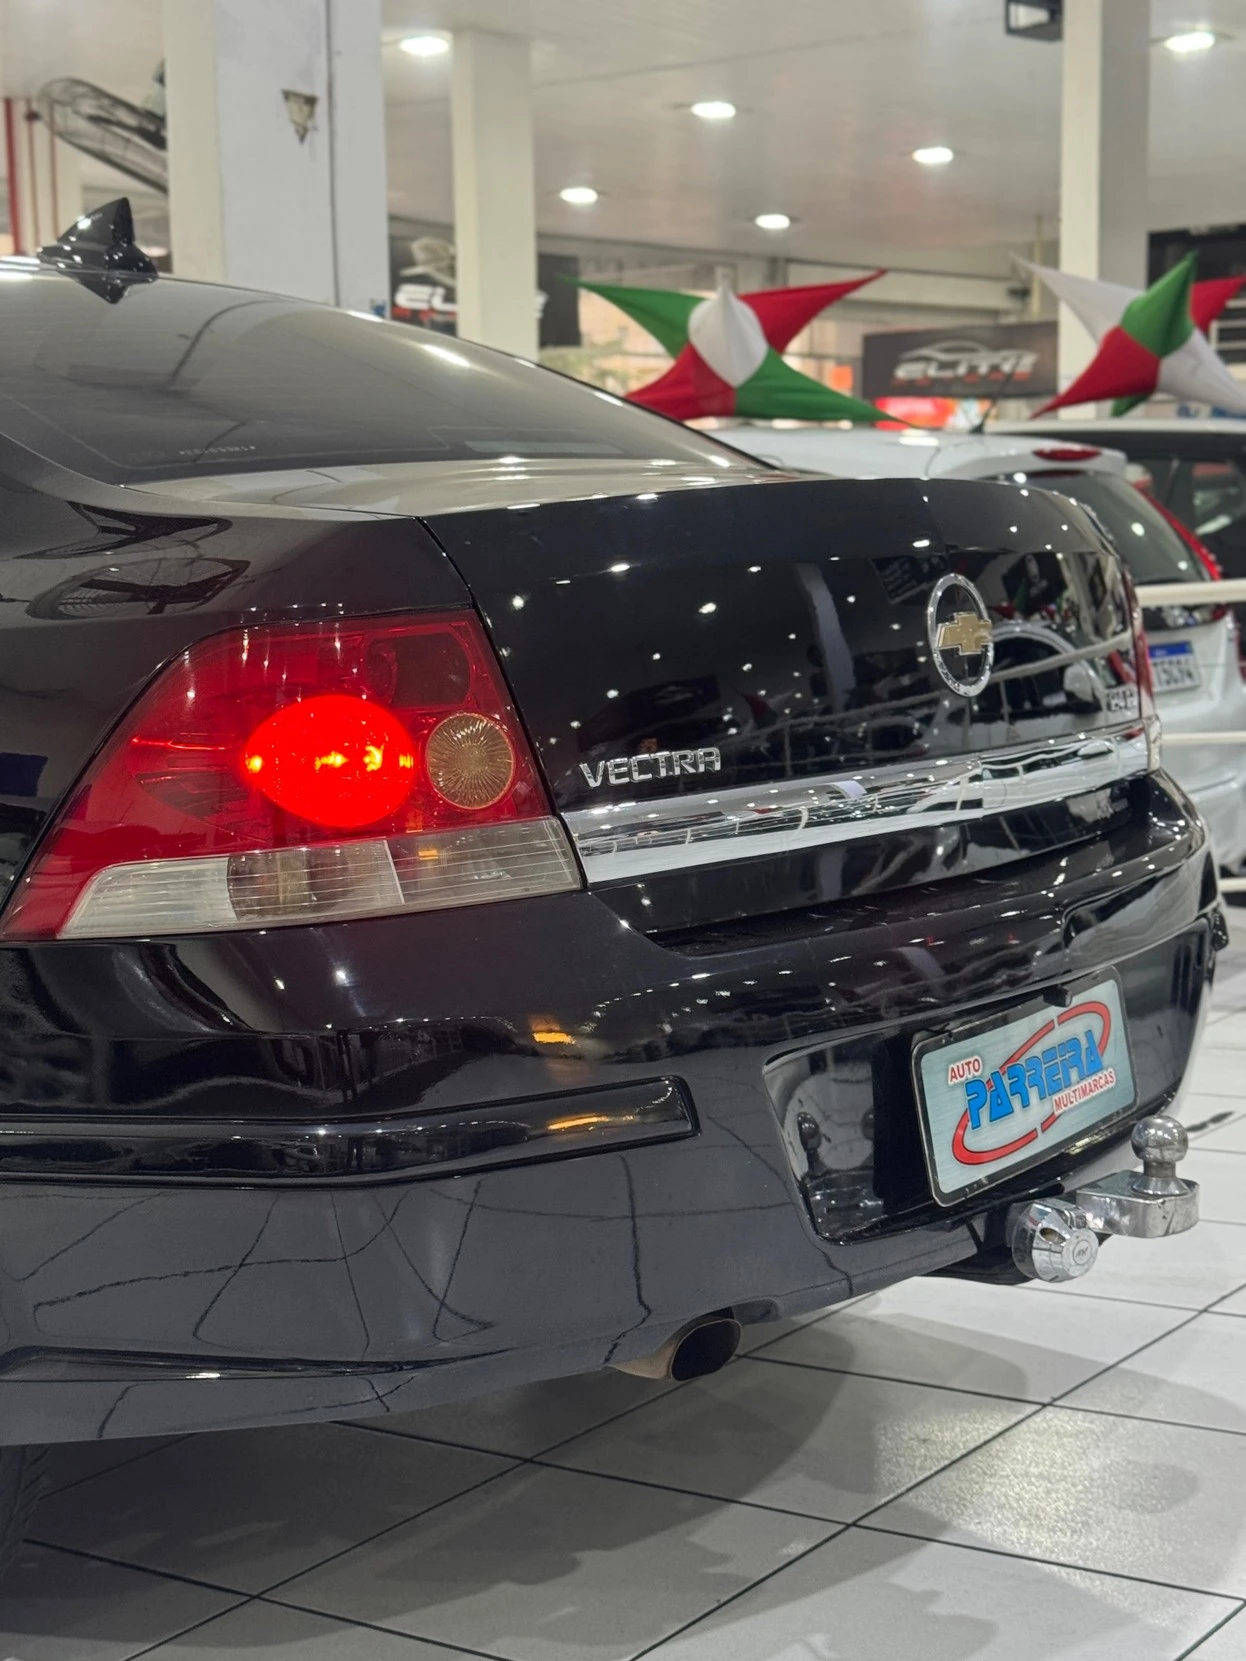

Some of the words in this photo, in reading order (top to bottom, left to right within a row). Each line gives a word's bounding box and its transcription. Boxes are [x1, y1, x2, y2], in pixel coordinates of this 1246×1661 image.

[579, 747, 721, 788] VECTRA
[950, 1058, 982, 1083] AUTO
[965, 1029, 1104, 1130] PARREIRA
[1054, 1071, 1115, 1111] MULTIMARCAS
